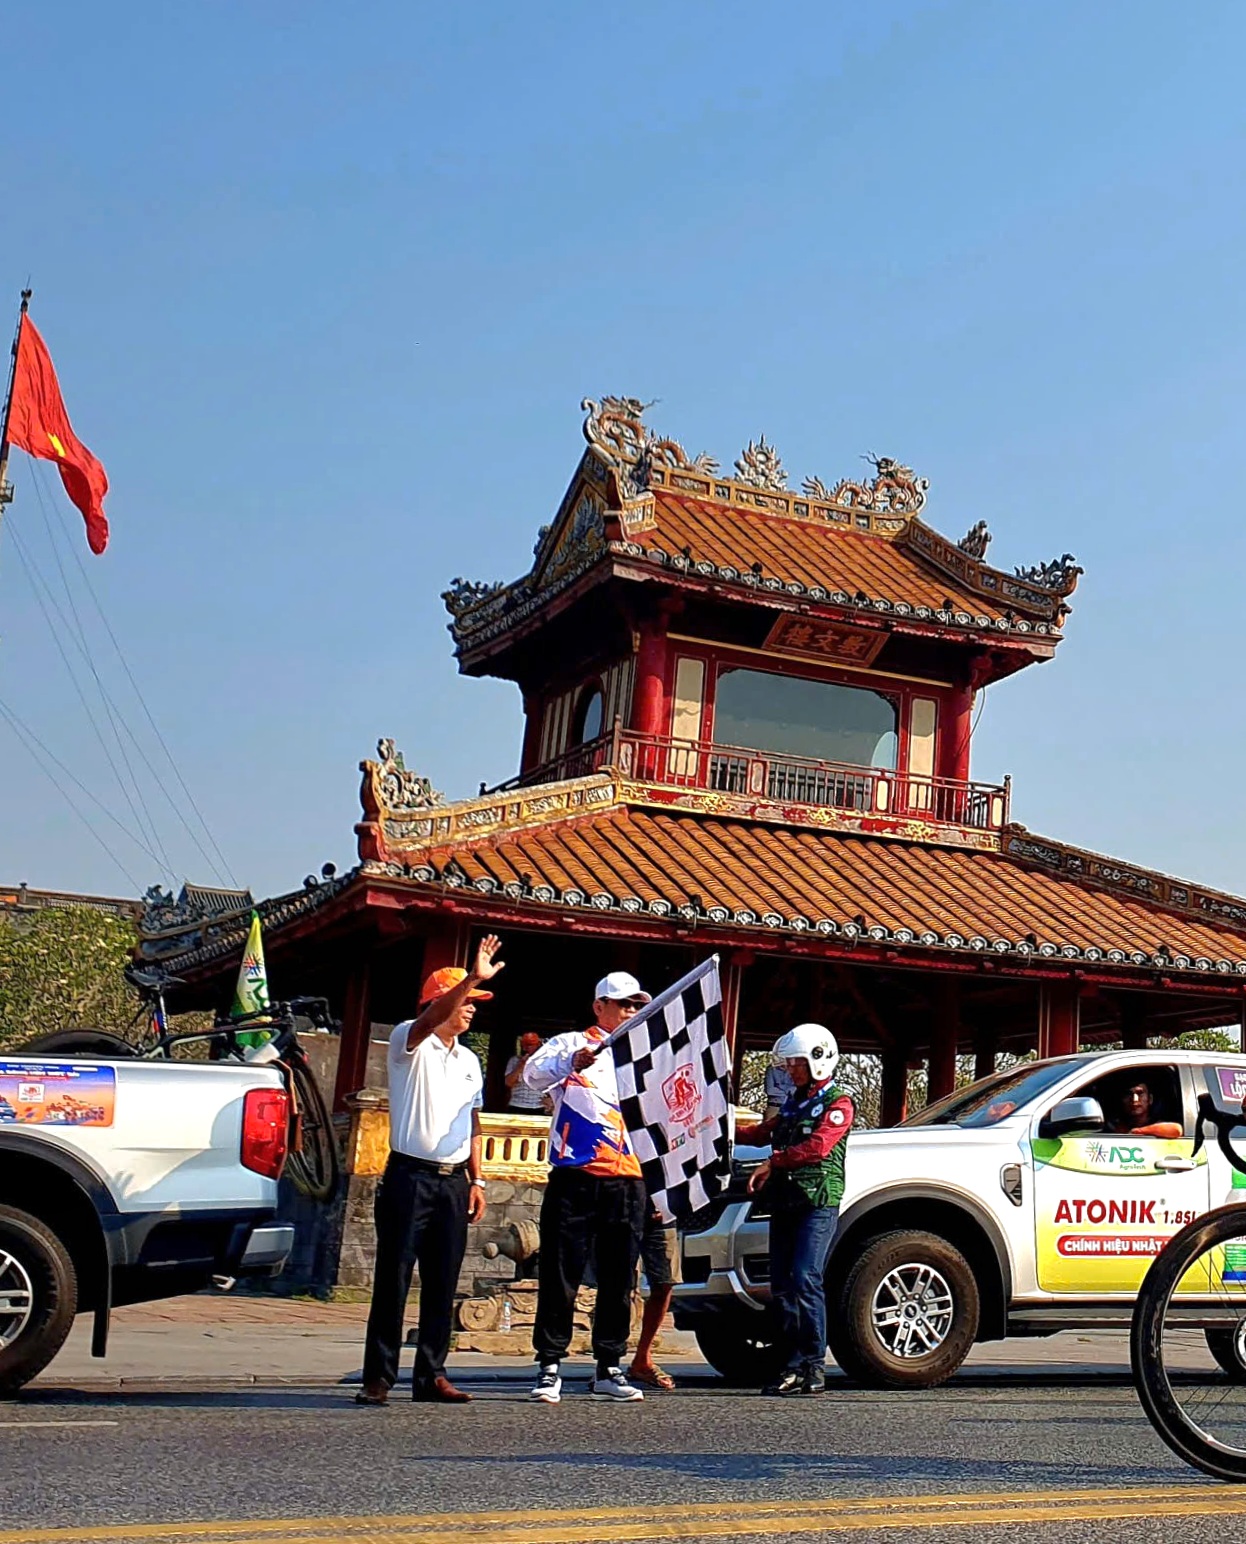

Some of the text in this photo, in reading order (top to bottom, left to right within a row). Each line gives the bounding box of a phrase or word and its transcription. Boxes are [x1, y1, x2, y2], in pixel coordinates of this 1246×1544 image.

[1109, 1146, 1145, 1163] ADC
[1054, 1199, 1156, 1224] ATONIK
[1064, 1238, 1163, 1254] CHÍNH HIỆU NHẬT
